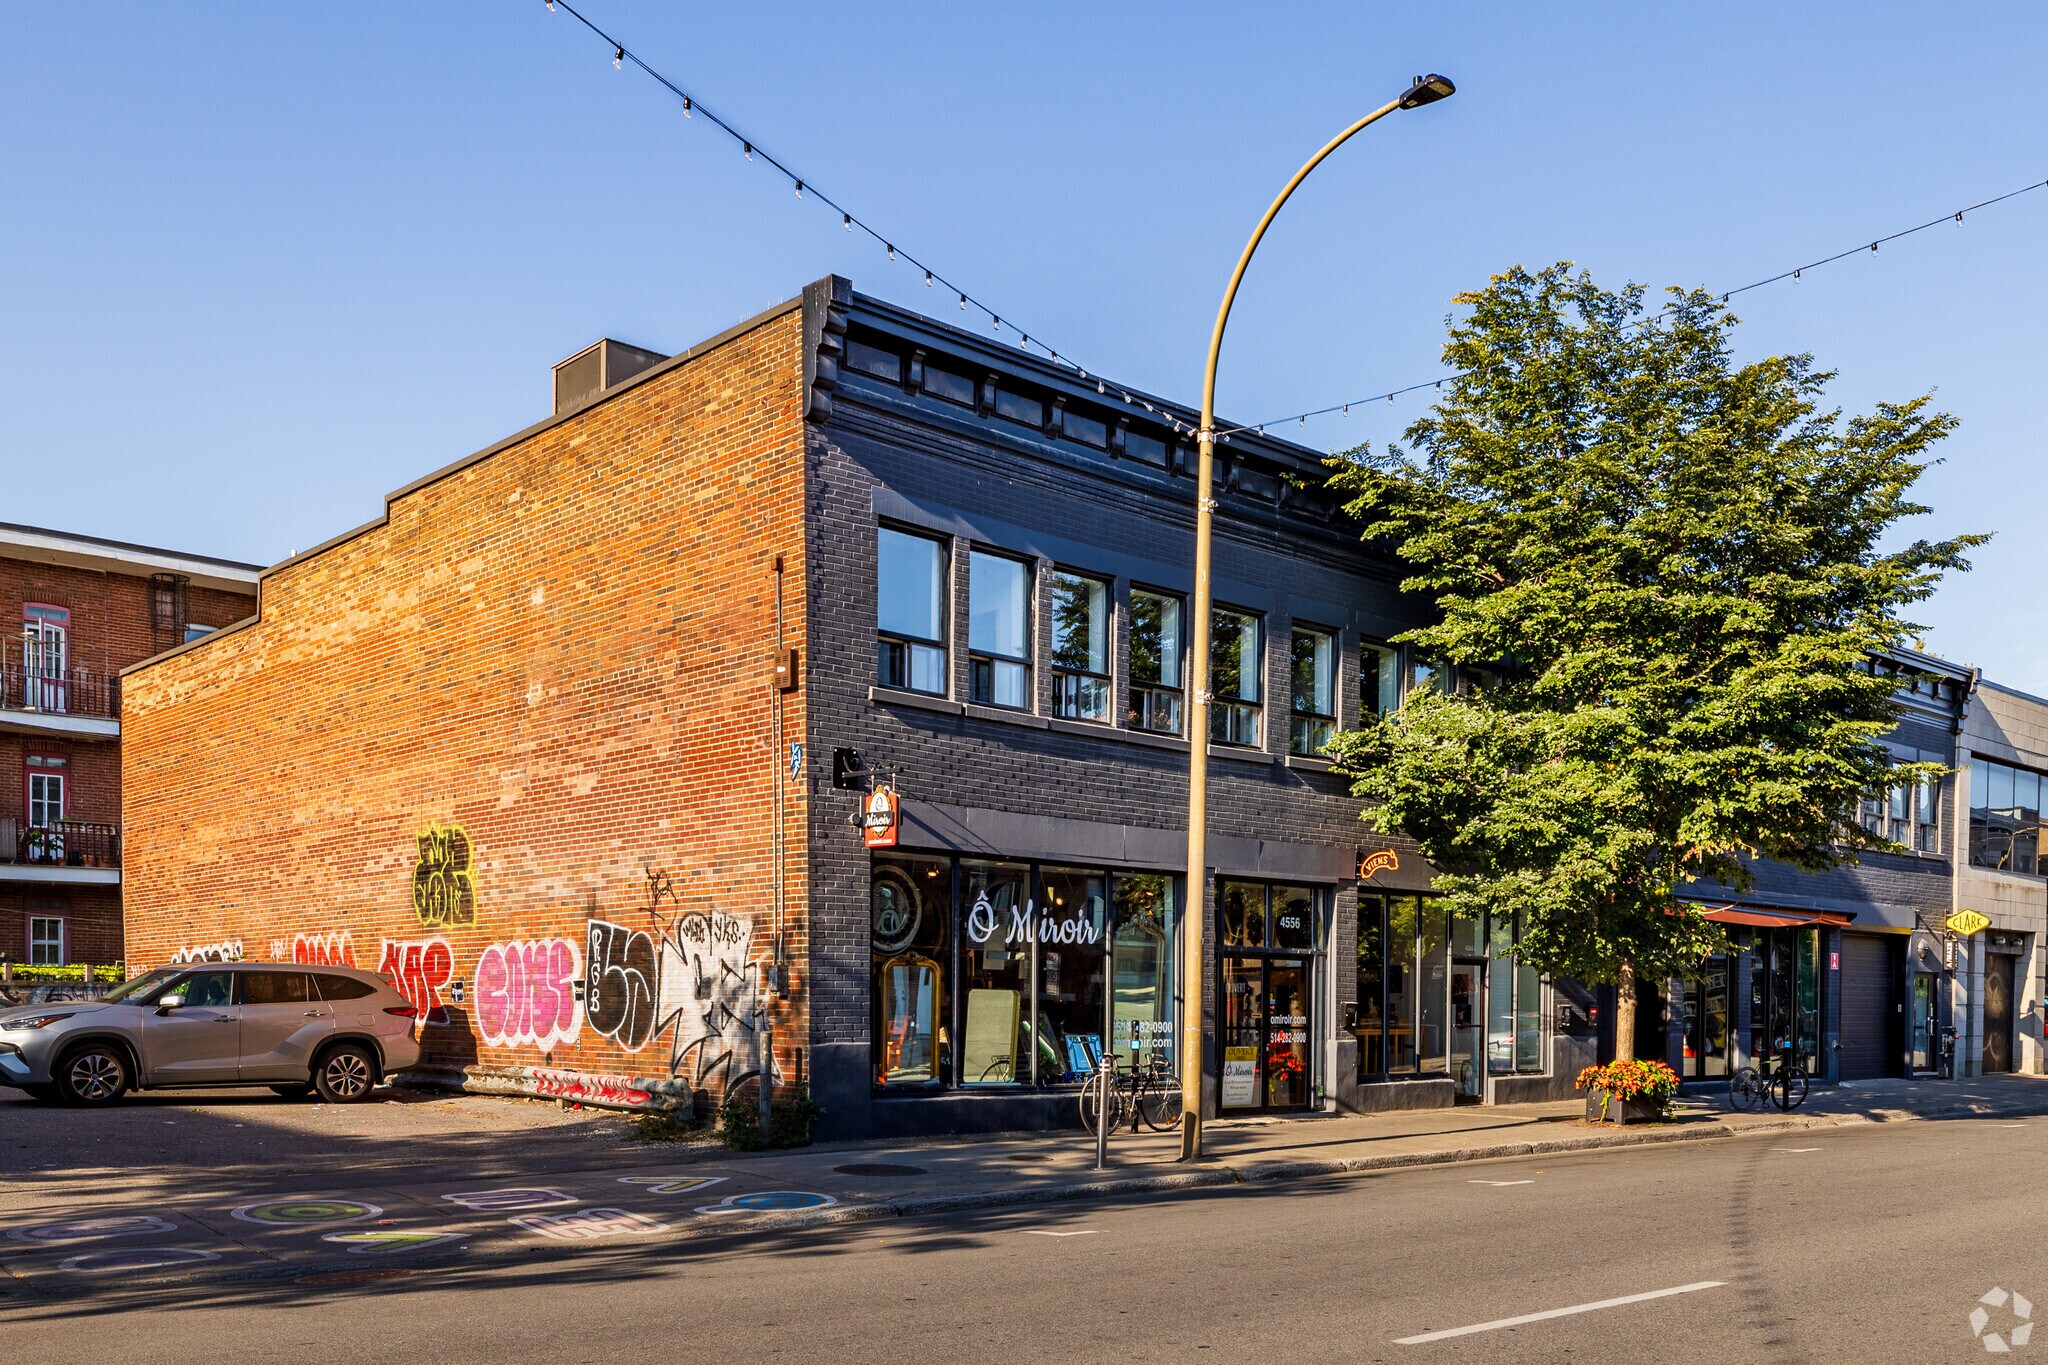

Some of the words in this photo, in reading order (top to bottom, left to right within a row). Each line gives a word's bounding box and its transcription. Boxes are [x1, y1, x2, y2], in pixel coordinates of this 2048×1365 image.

[864, 812, 891, 827] Miroir
[1365, 855, 1388, 871] VIENS
[968, 889, 999, 943] Ô
[1005, 899, 1100, 945] Miroir
[1279, 916, 1301, 929] 4556
[1952, 913, 1982, 932] CLARK
[1270, 1014, 1307, 1025] omiroir.com
[1228, 1047, 1255, 1056] OUVERT
